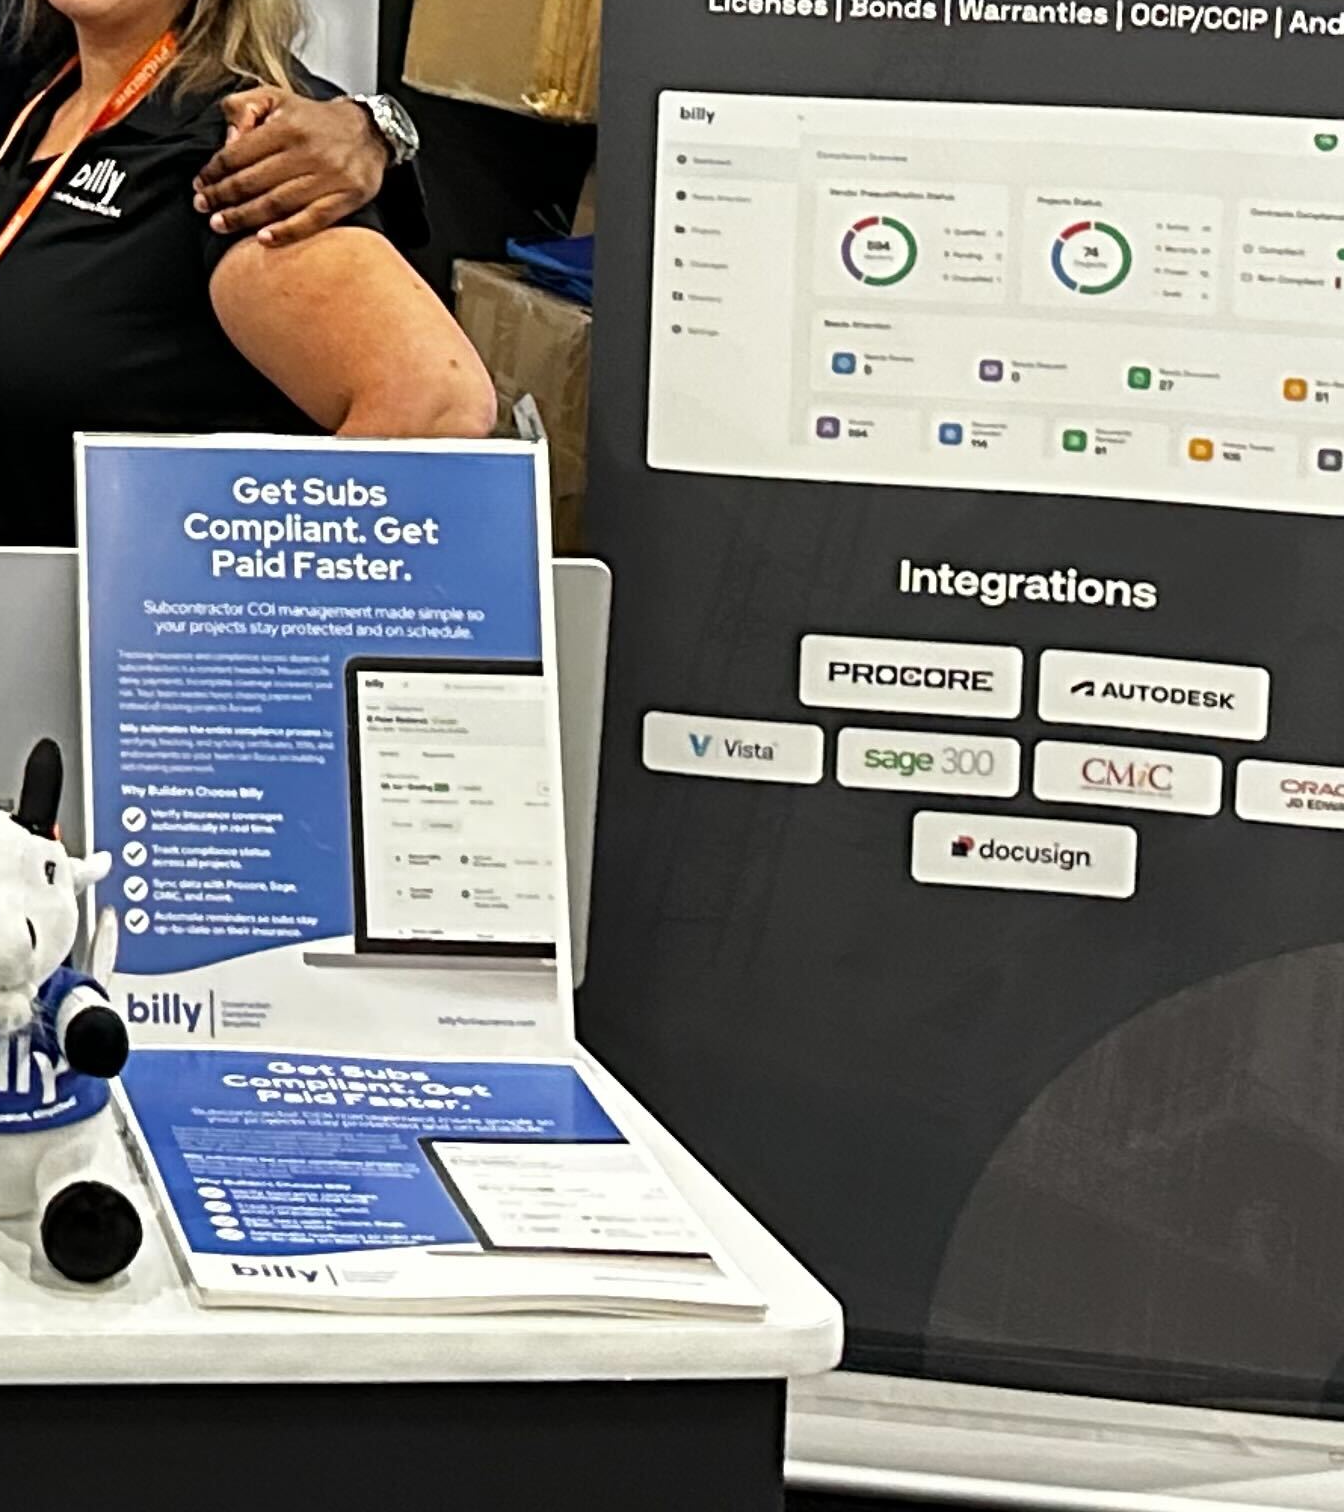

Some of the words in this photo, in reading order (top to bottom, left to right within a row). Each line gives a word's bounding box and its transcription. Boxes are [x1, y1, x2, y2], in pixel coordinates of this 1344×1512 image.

[1131, 3, 1268, 33] OCIP/CCIP
[1289, 10, 1344, 35] And
[680, 106, 715, 124] billy
[233, 477, 296, 504] Get
[303, 478, 387, 507] Subs
[184, 513, 366, 548] Compliant.
[374, 517, 438, 544] Get
[213, 549, 285, 578] Paid
[294, 552, 411, 581] Faster.
[900, 560, 1156, 608] Integrations
[143, 600, 243, 616] Subcontractor
[247, 602, 275, 616] COI
[278, 604, 371, 621] management
[375, 604, 416, 619] made
[418, 606, 465, 624] simple
[468, 609, 484, 622] so
[154, 622, 187, 635] your
[190, 621, 247, 637] projects
[250, 621, 279, 638] stay
[281, 621, 353, 637] protected
[356, 623, 382, 637] and
[385, 627, 404, 638] on
[406, 624, 474, 640] schedule.
[829, 662, 993, 691] PROCORE
[1102, 682, 1234, 709] AUTODESK
[724, 737, 774, 761] Vista
[864, 747, 934, 774] sage
[940, 747, 994, 776] 300
[1082, 758, 1173, 791] CMiC
[978, 838, 1091, 869] docusign
[128, 993, 202, 1032] billy
[222, 1073, 415, 1096] Compliant.
[421, 1082, 492, 1099] Get
[267, 1061, 334, 1078] Get
[340, 1064, 430, 1083] Subs
[256, 1088, 339, 1107] Paid
[343, 1092, 471, 1112] Faster.
[231, 1262, 318, 1284] billy
